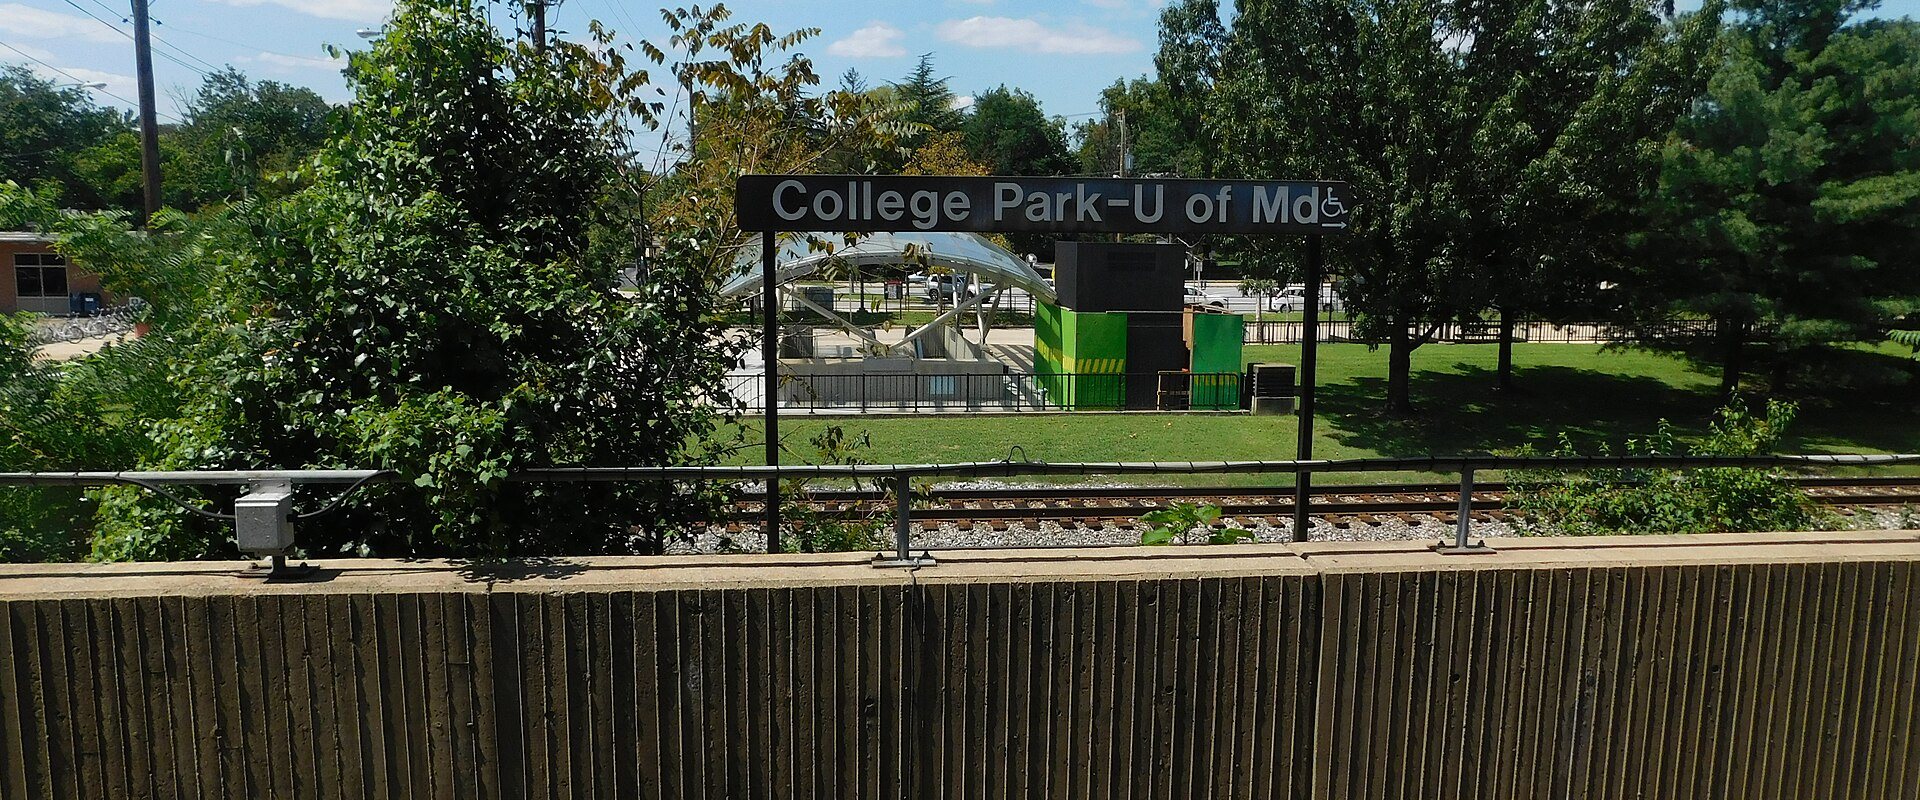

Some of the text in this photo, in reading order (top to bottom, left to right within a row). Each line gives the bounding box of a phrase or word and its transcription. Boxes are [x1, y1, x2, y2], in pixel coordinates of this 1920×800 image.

[772, 180, 1319, 229] College Park-U of Md
